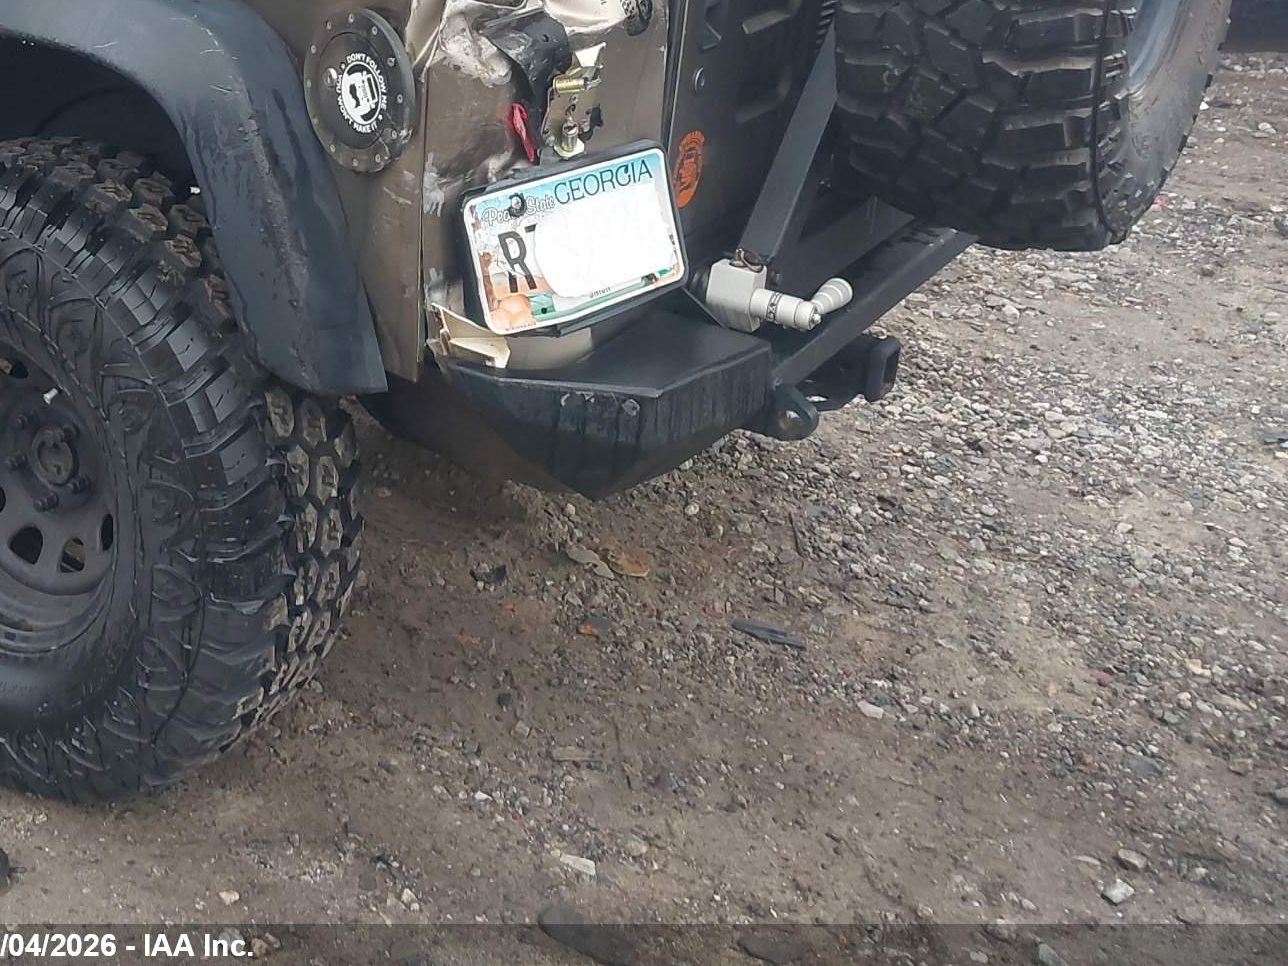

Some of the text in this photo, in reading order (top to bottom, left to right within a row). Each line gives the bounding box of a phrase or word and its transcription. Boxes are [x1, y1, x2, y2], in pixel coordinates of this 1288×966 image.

[346, 53, 387, 111] DON'T FOLLOW ME
[337, 96, 353, 125] WON'T
[353, 122, 371, 133] MAKE
[371, 121, 378, 131] IT
[554, 159, 653, 205] GEORGIA
[482, 194, 555, 227] Pea State
